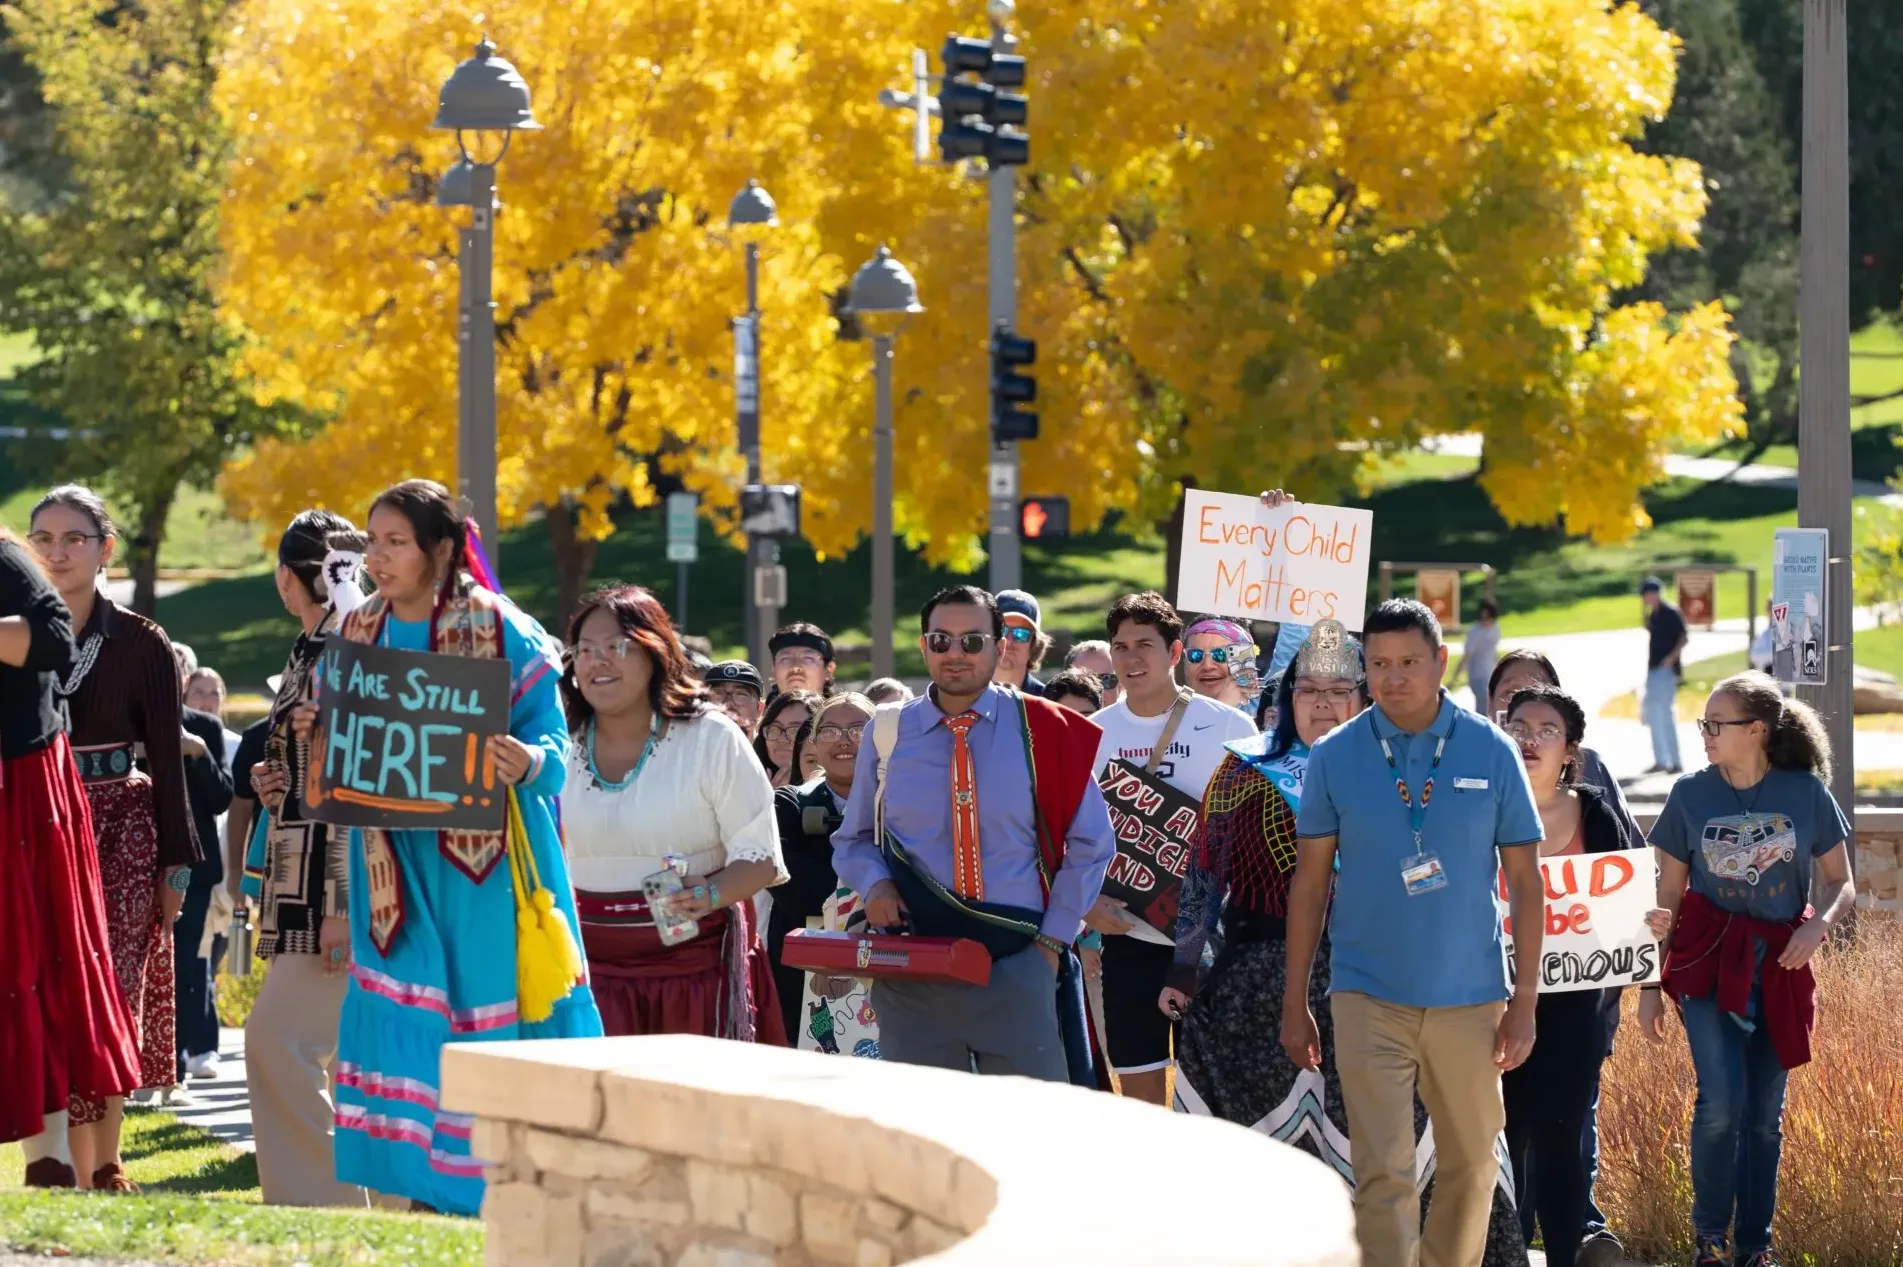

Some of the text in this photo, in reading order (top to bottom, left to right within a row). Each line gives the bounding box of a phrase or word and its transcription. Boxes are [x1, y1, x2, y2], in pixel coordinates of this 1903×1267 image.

[1199, 505, 1358, 565] Every Child
[1214, 559, 1338, 619] Matters
[326, 649, 487, 716] WE ARE STILL
[325, 707, 498, 808] HERE!!
[1097, 760, 1165, 817] YOU
[1107, 851, 1156, 892] ND
[1540, 854, 1635, 901] UD
